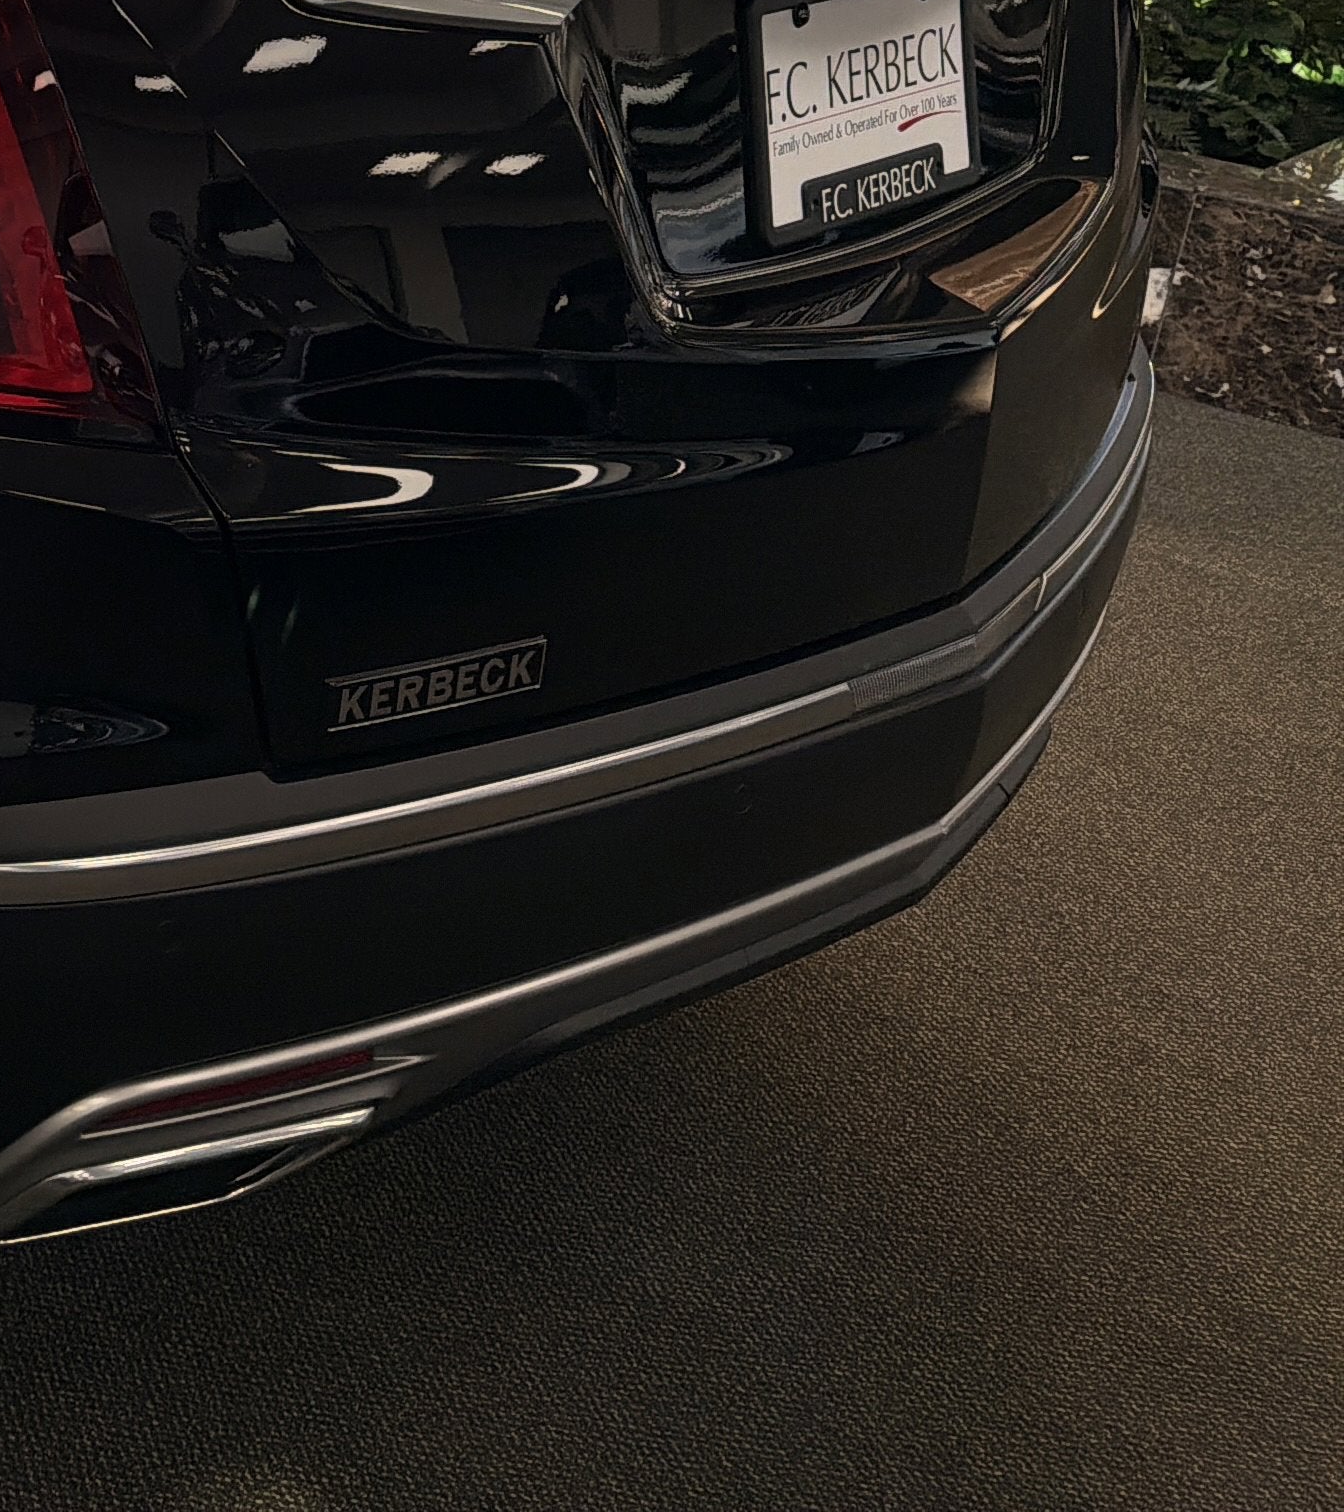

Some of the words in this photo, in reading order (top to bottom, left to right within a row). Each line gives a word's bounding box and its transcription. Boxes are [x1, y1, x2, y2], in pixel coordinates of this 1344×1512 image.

[766, 61, 818, 126] F.C.
[827, 24, 959, 109] KERBECK
[773, 136, 800, 157] Family
[802, 128, 834, 149] Owned
[835, 124, 843, 139] &
[844, 115, 883, 139] Operated
[885, 107, 898, 125] For
[899, 102, 920, 120] Over
[921, 96, 936, 114] 100
[937, 93, 958, 109] Years
[821, 183, 854, 223] F.C.
[856, 157, 936, 214] KERBECK
[338, 650, 537, 725] KERBECK
